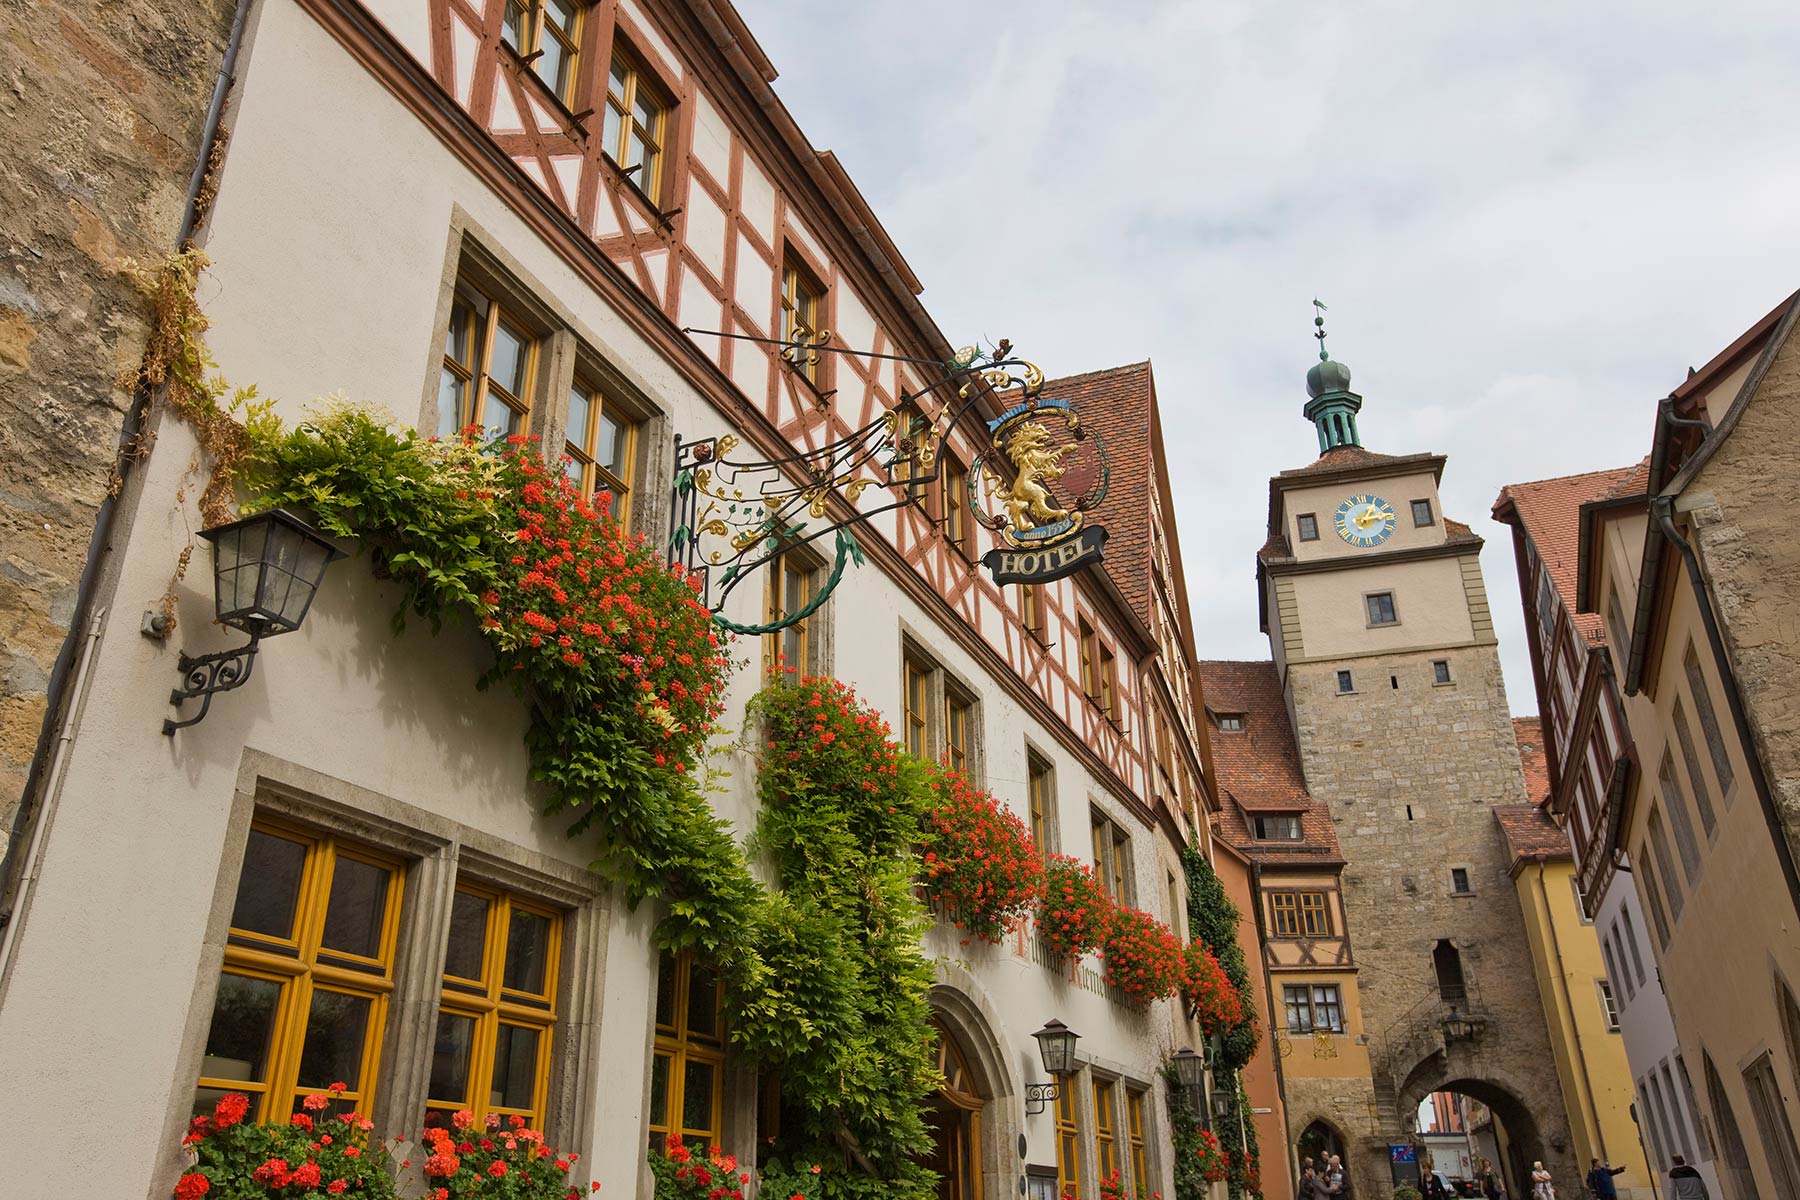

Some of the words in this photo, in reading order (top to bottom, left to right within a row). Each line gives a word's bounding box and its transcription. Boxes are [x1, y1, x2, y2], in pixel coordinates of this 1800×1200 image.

[1023, 531, 1046, 540] anno
[1046, 519, 1071, 537] 1559
[999, 536, 1095, 575] HOTEL
